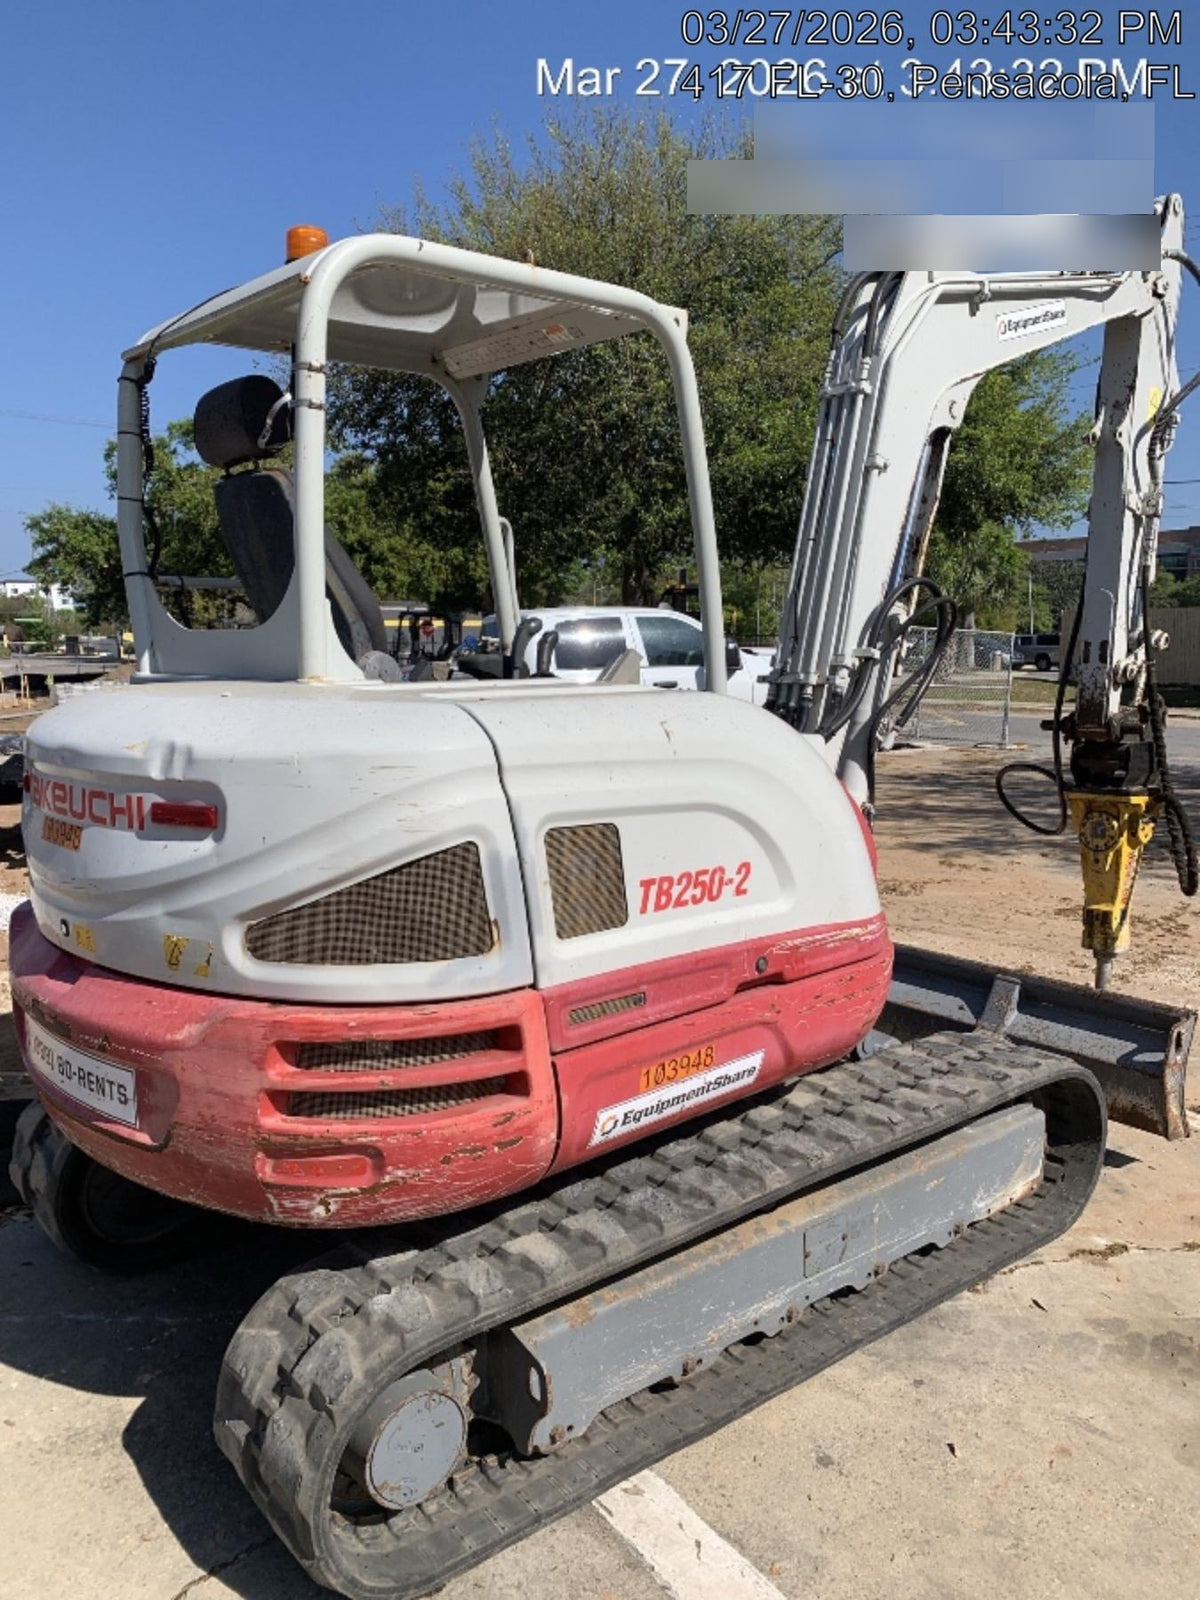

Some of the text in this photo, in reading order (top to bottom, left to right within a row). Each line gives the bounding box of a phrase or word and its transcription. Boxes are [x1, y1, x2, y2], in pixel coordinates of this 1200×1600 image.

[639, 861, 751, 914] TB250-2
[642, 1046, 714, 1088] 103948
[620, 1066, 757, 1127] EquipmentShare
